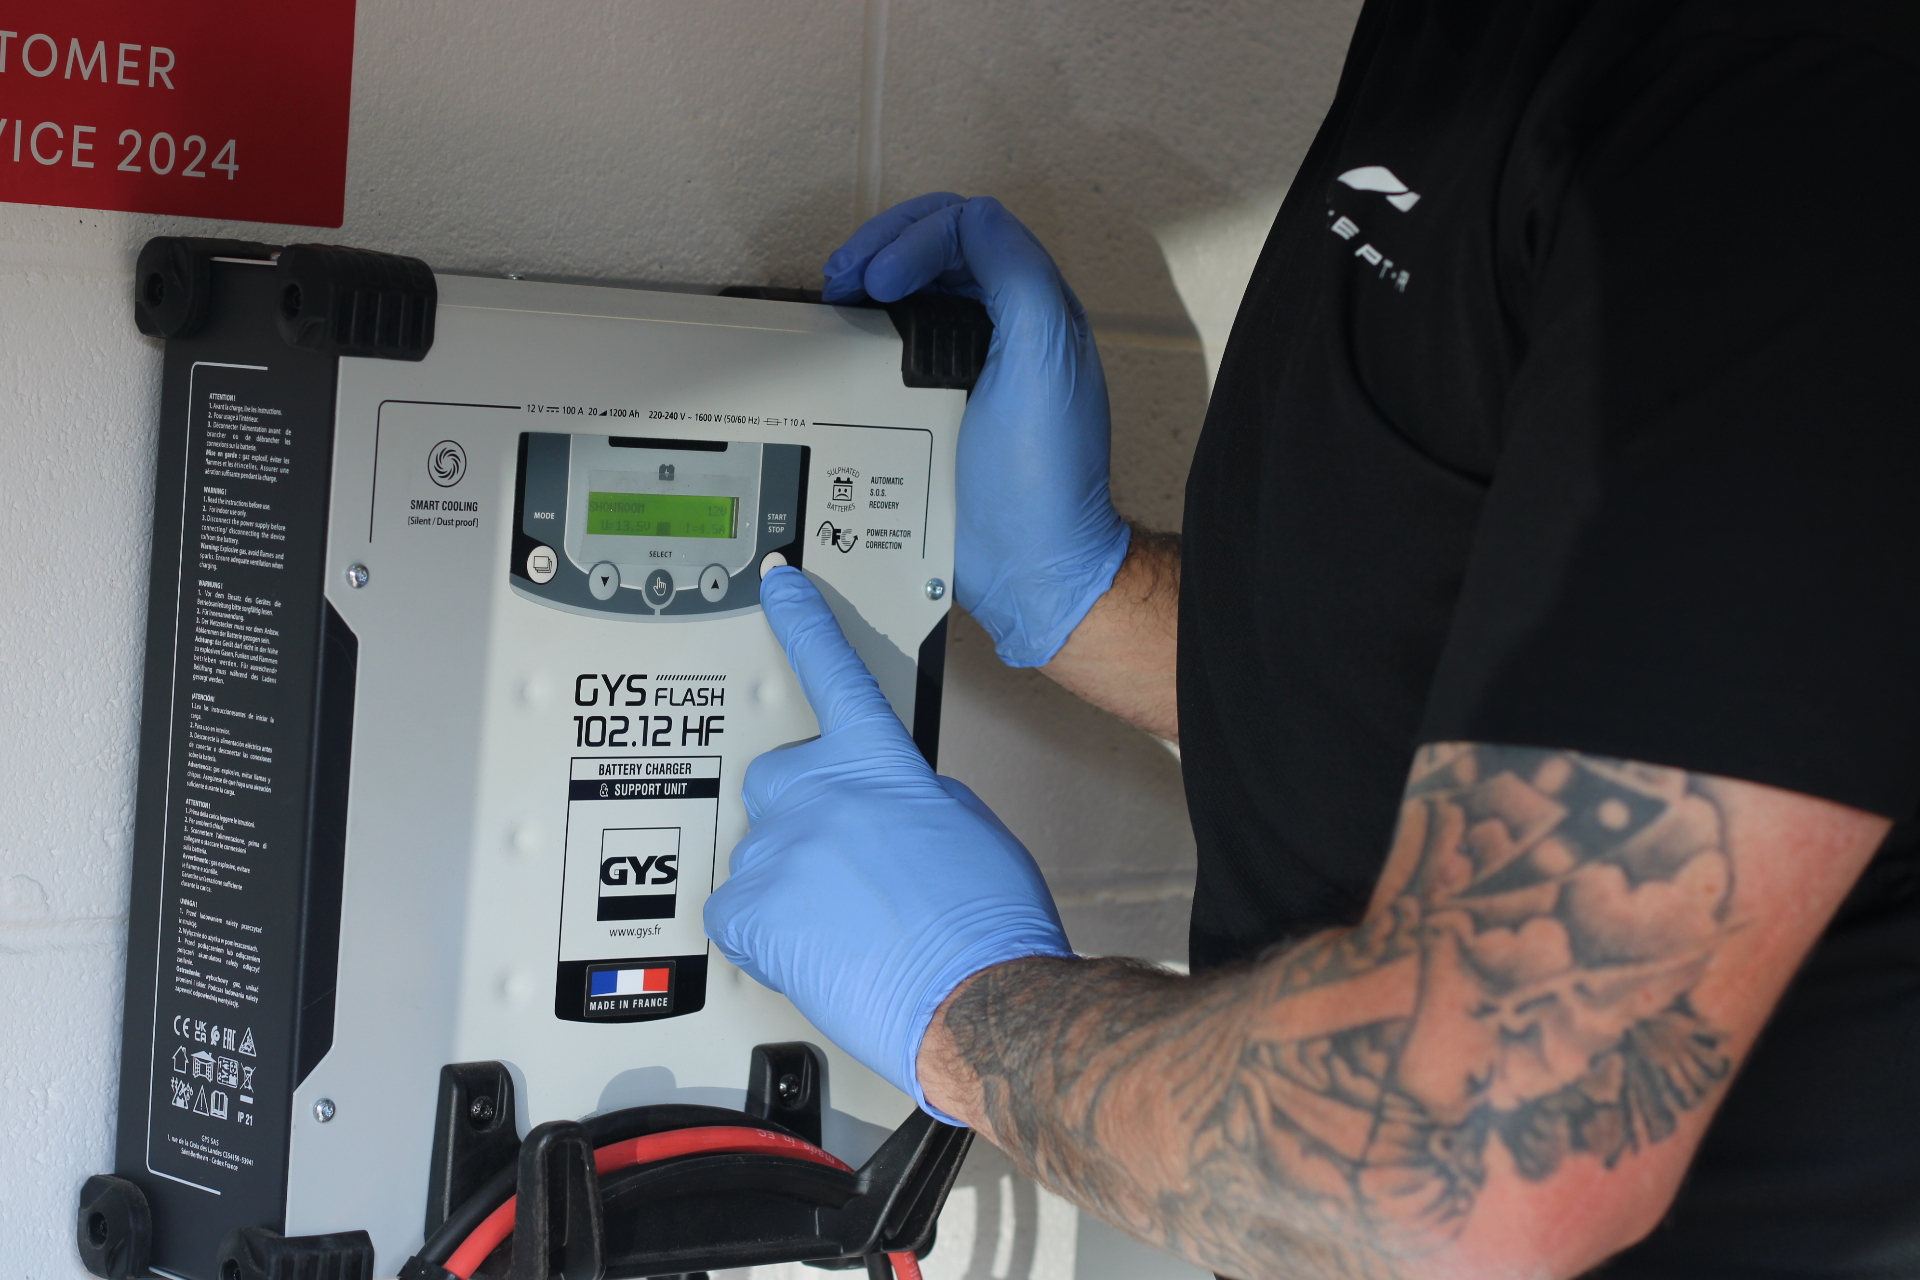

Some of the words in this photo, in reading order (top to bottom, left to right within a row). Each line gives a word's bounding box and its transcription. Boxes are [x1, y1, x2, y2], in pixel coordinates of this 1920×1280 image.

[0, 118, 97, 169] ICE
[117, 129, 240, 181] 2024
[527, 404, 536, 413] 12
[538, 405, 544, 413] V
[563, 406, 575, 415] 100
[577, 407, 584, 415] A
[588, 407, 598, 416] 20
[609, 409, 627, 418] 1200
[629, 409, 640, 418] Ah
[648, 410, 679, 421] 220-240
[680, 413, 686, 421] V
[695, 413, 712, 422] 1600
[714, 414, 723, 423] W
[724, 414, 746, 424] (50/60
[748, 416, 760, 425] Hz)
[783, 418, 788, 426] T
[790, 418, 799, 427] 10
[800, 419, 806, 427] A
[827, 466, 860, 478] SULPHATED
[870, 476, 904, 485] AUTOMATIC
[869, 488, 887, 497] S.O.S.
[410, 500, 440, 511] SMART
[442, 500, 478, 512] COOLING
[590, 500, 645, 514] SHOWROOM
[707, 506, 727, 516] 12V
[827, 502, 856, 513] BATTERIES
[869, 501, 899, 510] RECOVERY
[533, 511, 555, 520] MODE
[767, 513, 787, 522] START
[408, 516, 431, 526] [Silent
[437, 517, 454, 526] Dust
[455, 517, 479, 528] proof]
[768, 525, 785, 533] STOP
[867, 529, 888, 537] POWER
[889, 529, 911, 538] FACTOR
[866, 541, 902, 550] CORRECTION
[574, 674, 648, 707] GYS
[654, 687, 725, 707] FLASH
[573, 715, 673, 747] 102.12
[681, 715, 725, 747] HF
[598, 763, 643, 776] BATTERY
[645, 762, 692, 775] CHARGER
[599, 782, 609, 797] &
[614, 783, 662, 796] SUPPORT
[664, 782, 688, 795] UNIT
[600, 854, 678, 886] GYS
[609, 923, 662, 939] www.gys.fr
[589, 999, 615, 1011] MADE
[619, 999, 628, 1009] IN
[632, 997, 668, 1008] FRANCE
[174, 1015, 190, 1039] CE
[195, 1019, 207, 1033] UK
[195, 1031, 207, 1043] CA
[237, 1111, 244, 1123] IP
[245, 1113, 253, 1126] 21
[781, 1135, 795, 1146] in
[803, 1142, 835, 1164] made
